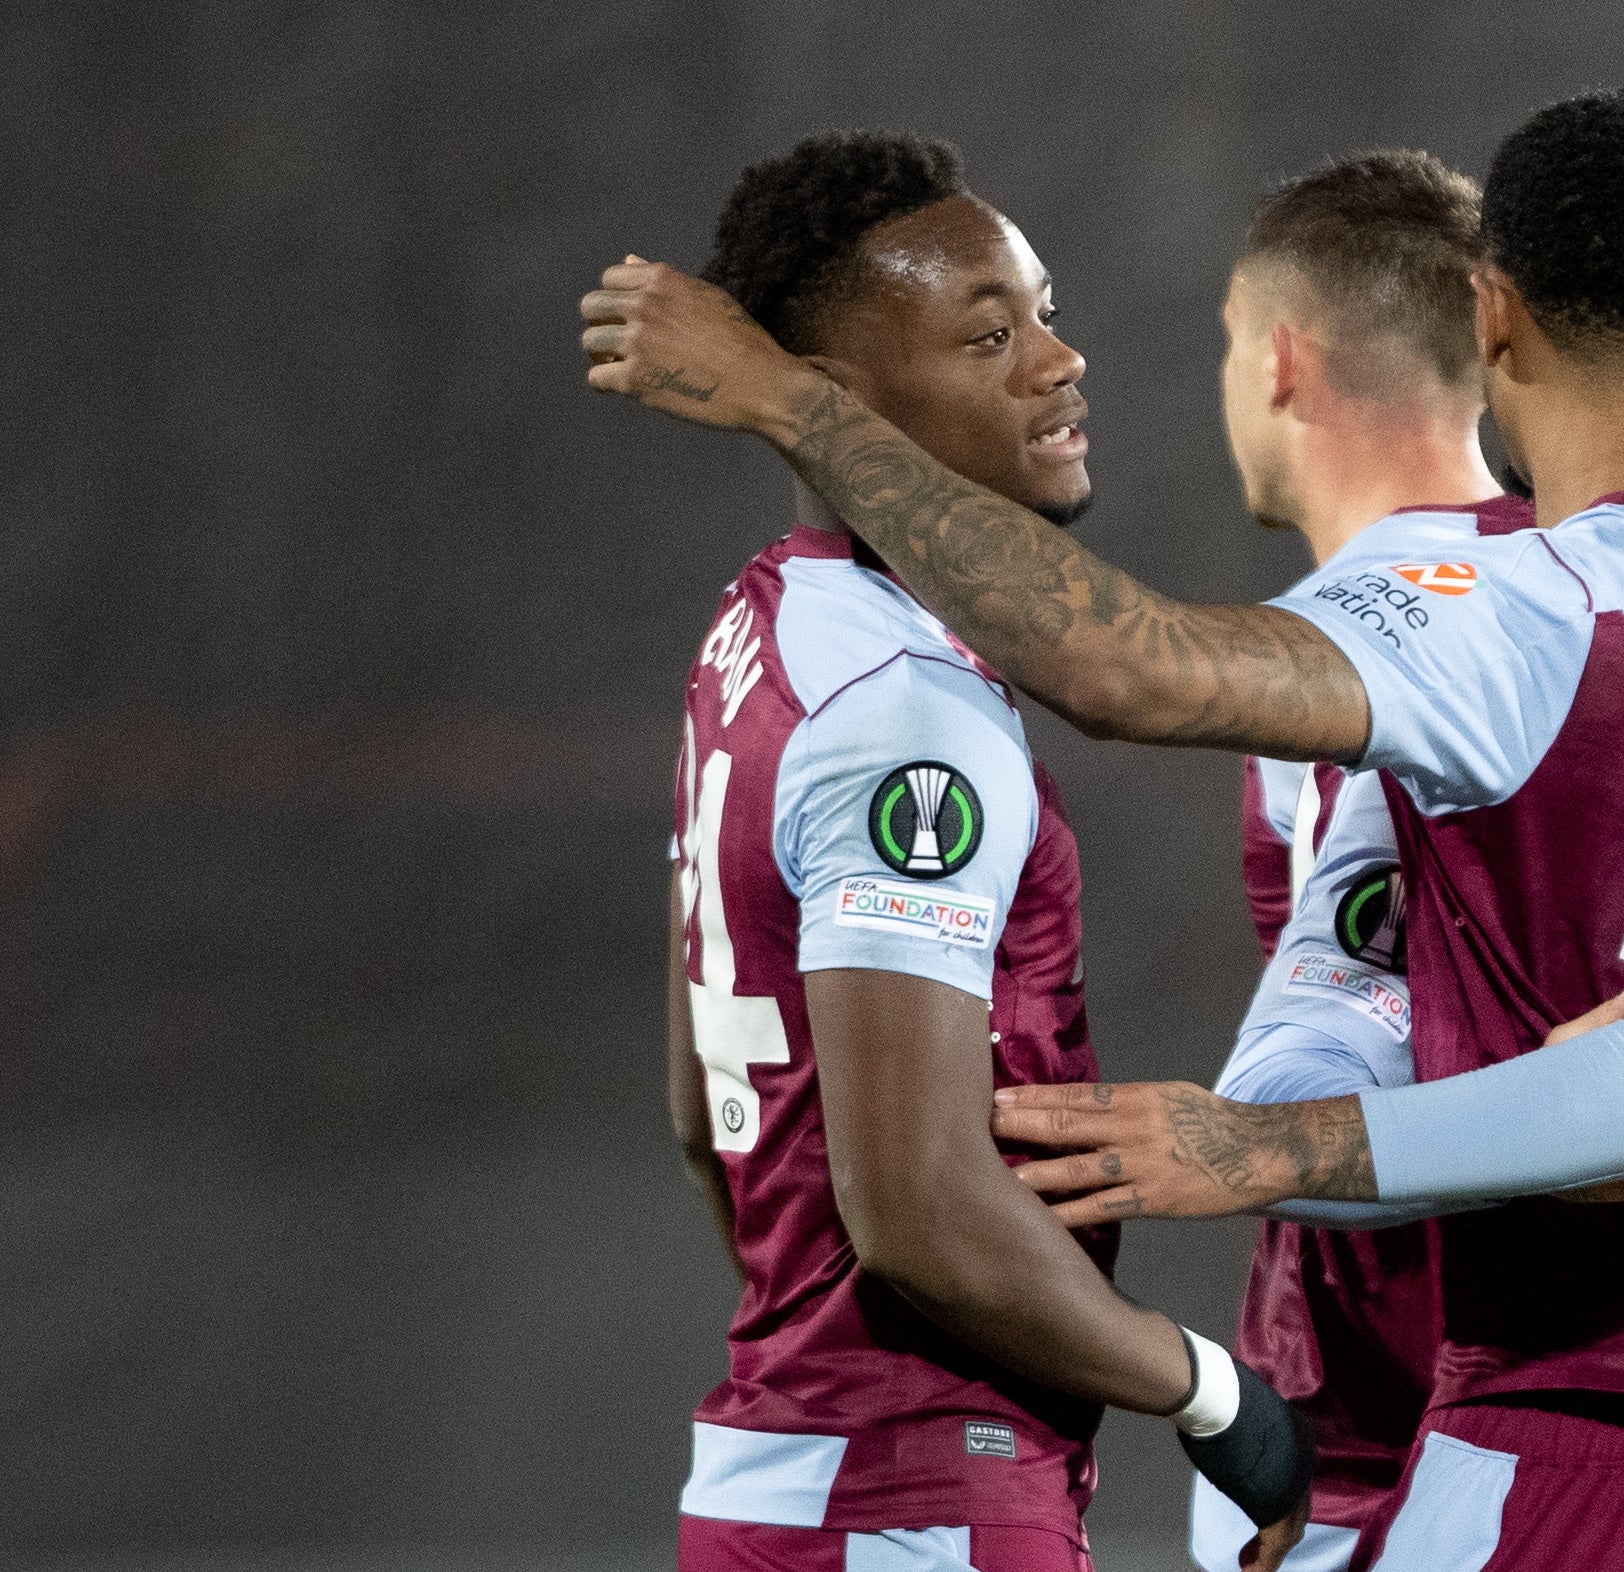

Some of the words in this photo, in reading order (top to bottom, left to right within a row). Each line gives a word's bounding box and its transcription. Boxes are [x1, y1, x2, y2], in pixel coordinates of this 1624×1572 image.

[1350, 572, 1430, 631] rade
[844, 880, 878, 893] UEFA
[841, 892, 989, 931] FOUNDATION
[969, 1425, 1011, 1438] CASTORE
